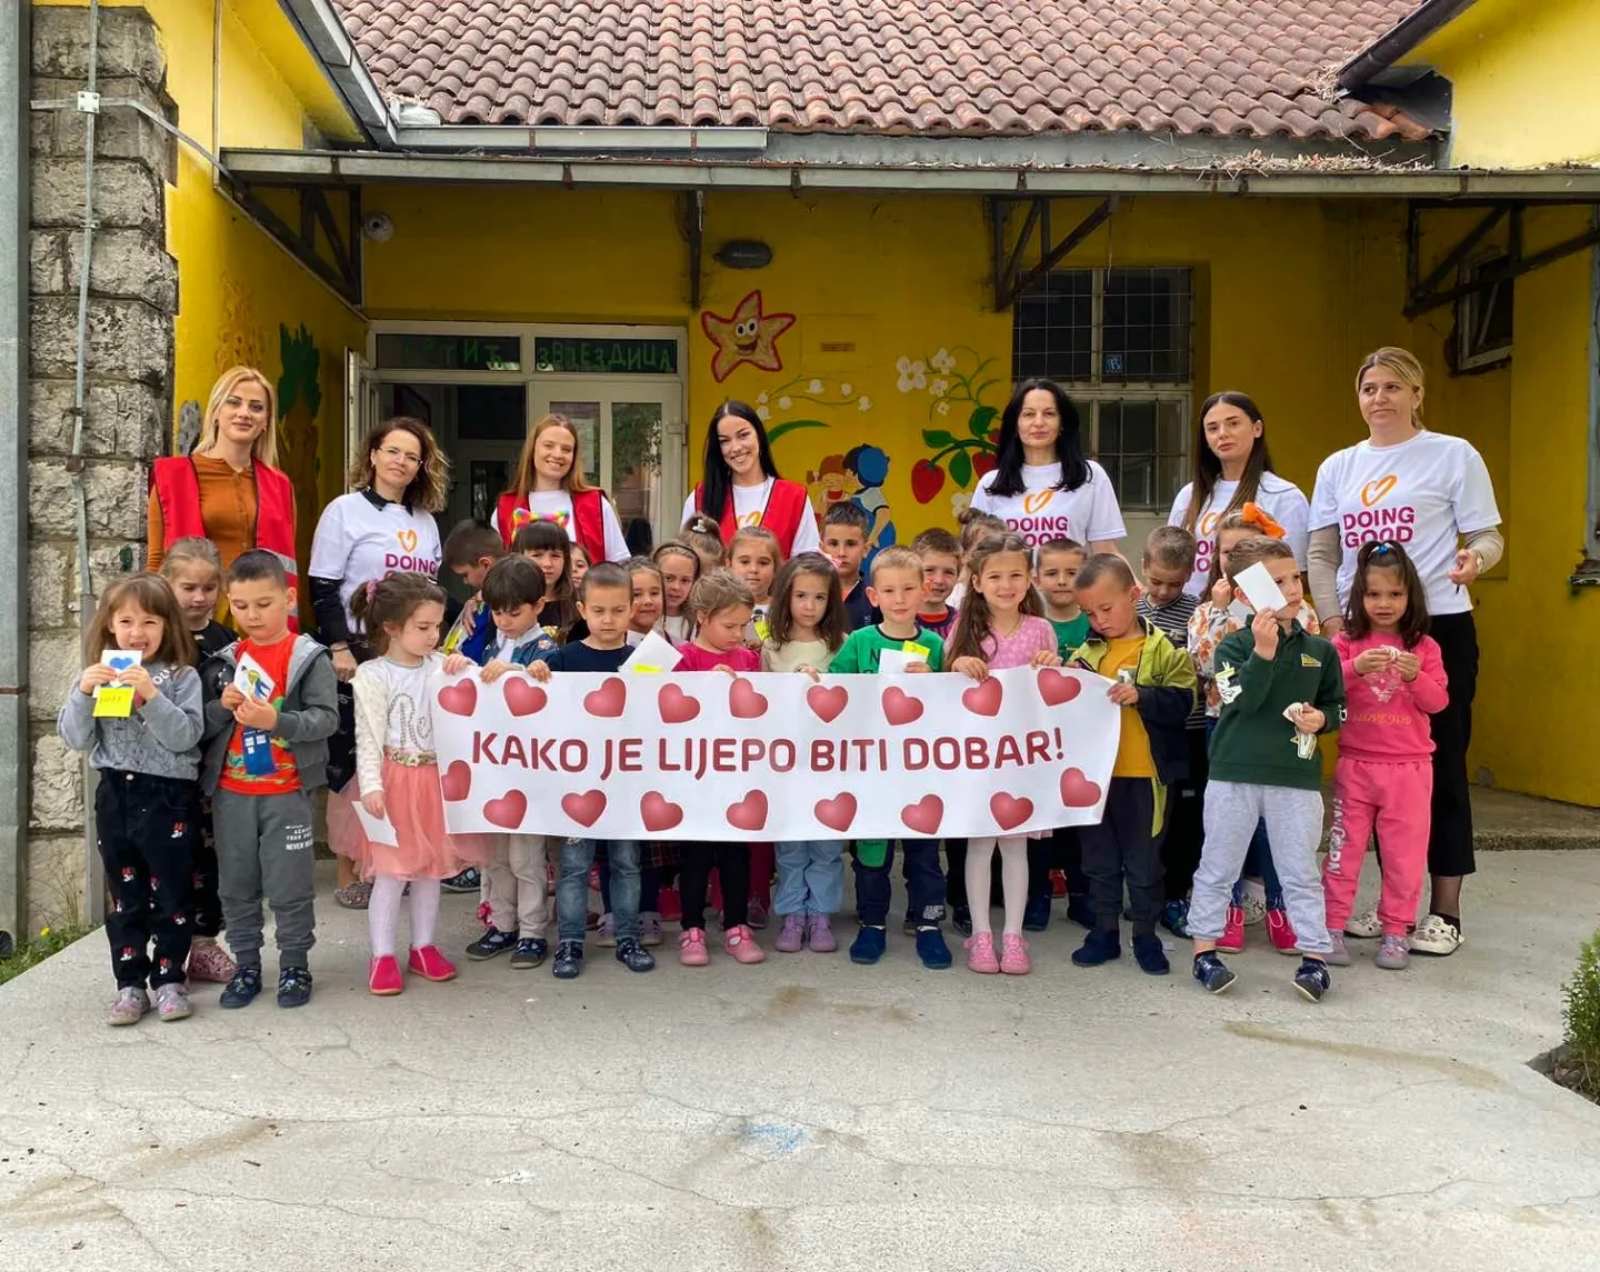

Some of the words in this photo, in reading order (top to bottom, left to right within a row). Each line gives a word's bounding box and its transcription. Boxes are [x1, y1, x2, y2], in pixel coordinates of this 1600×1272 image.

[1006, 517, 1068, 532] DOING
[1344, 506, 1415, 530] DOING
[1344, 526, 1414, 548] GOOD
[385, 553, 437, 575] DOING
[472, 731, 588, 773] KAKO
[600, 738, 643, 781] JE
[658, 738, 796, 781] LIJEPO
[810, 738, 887, 772] BITI
[902, 727, 1064, 771] DOBAR!
